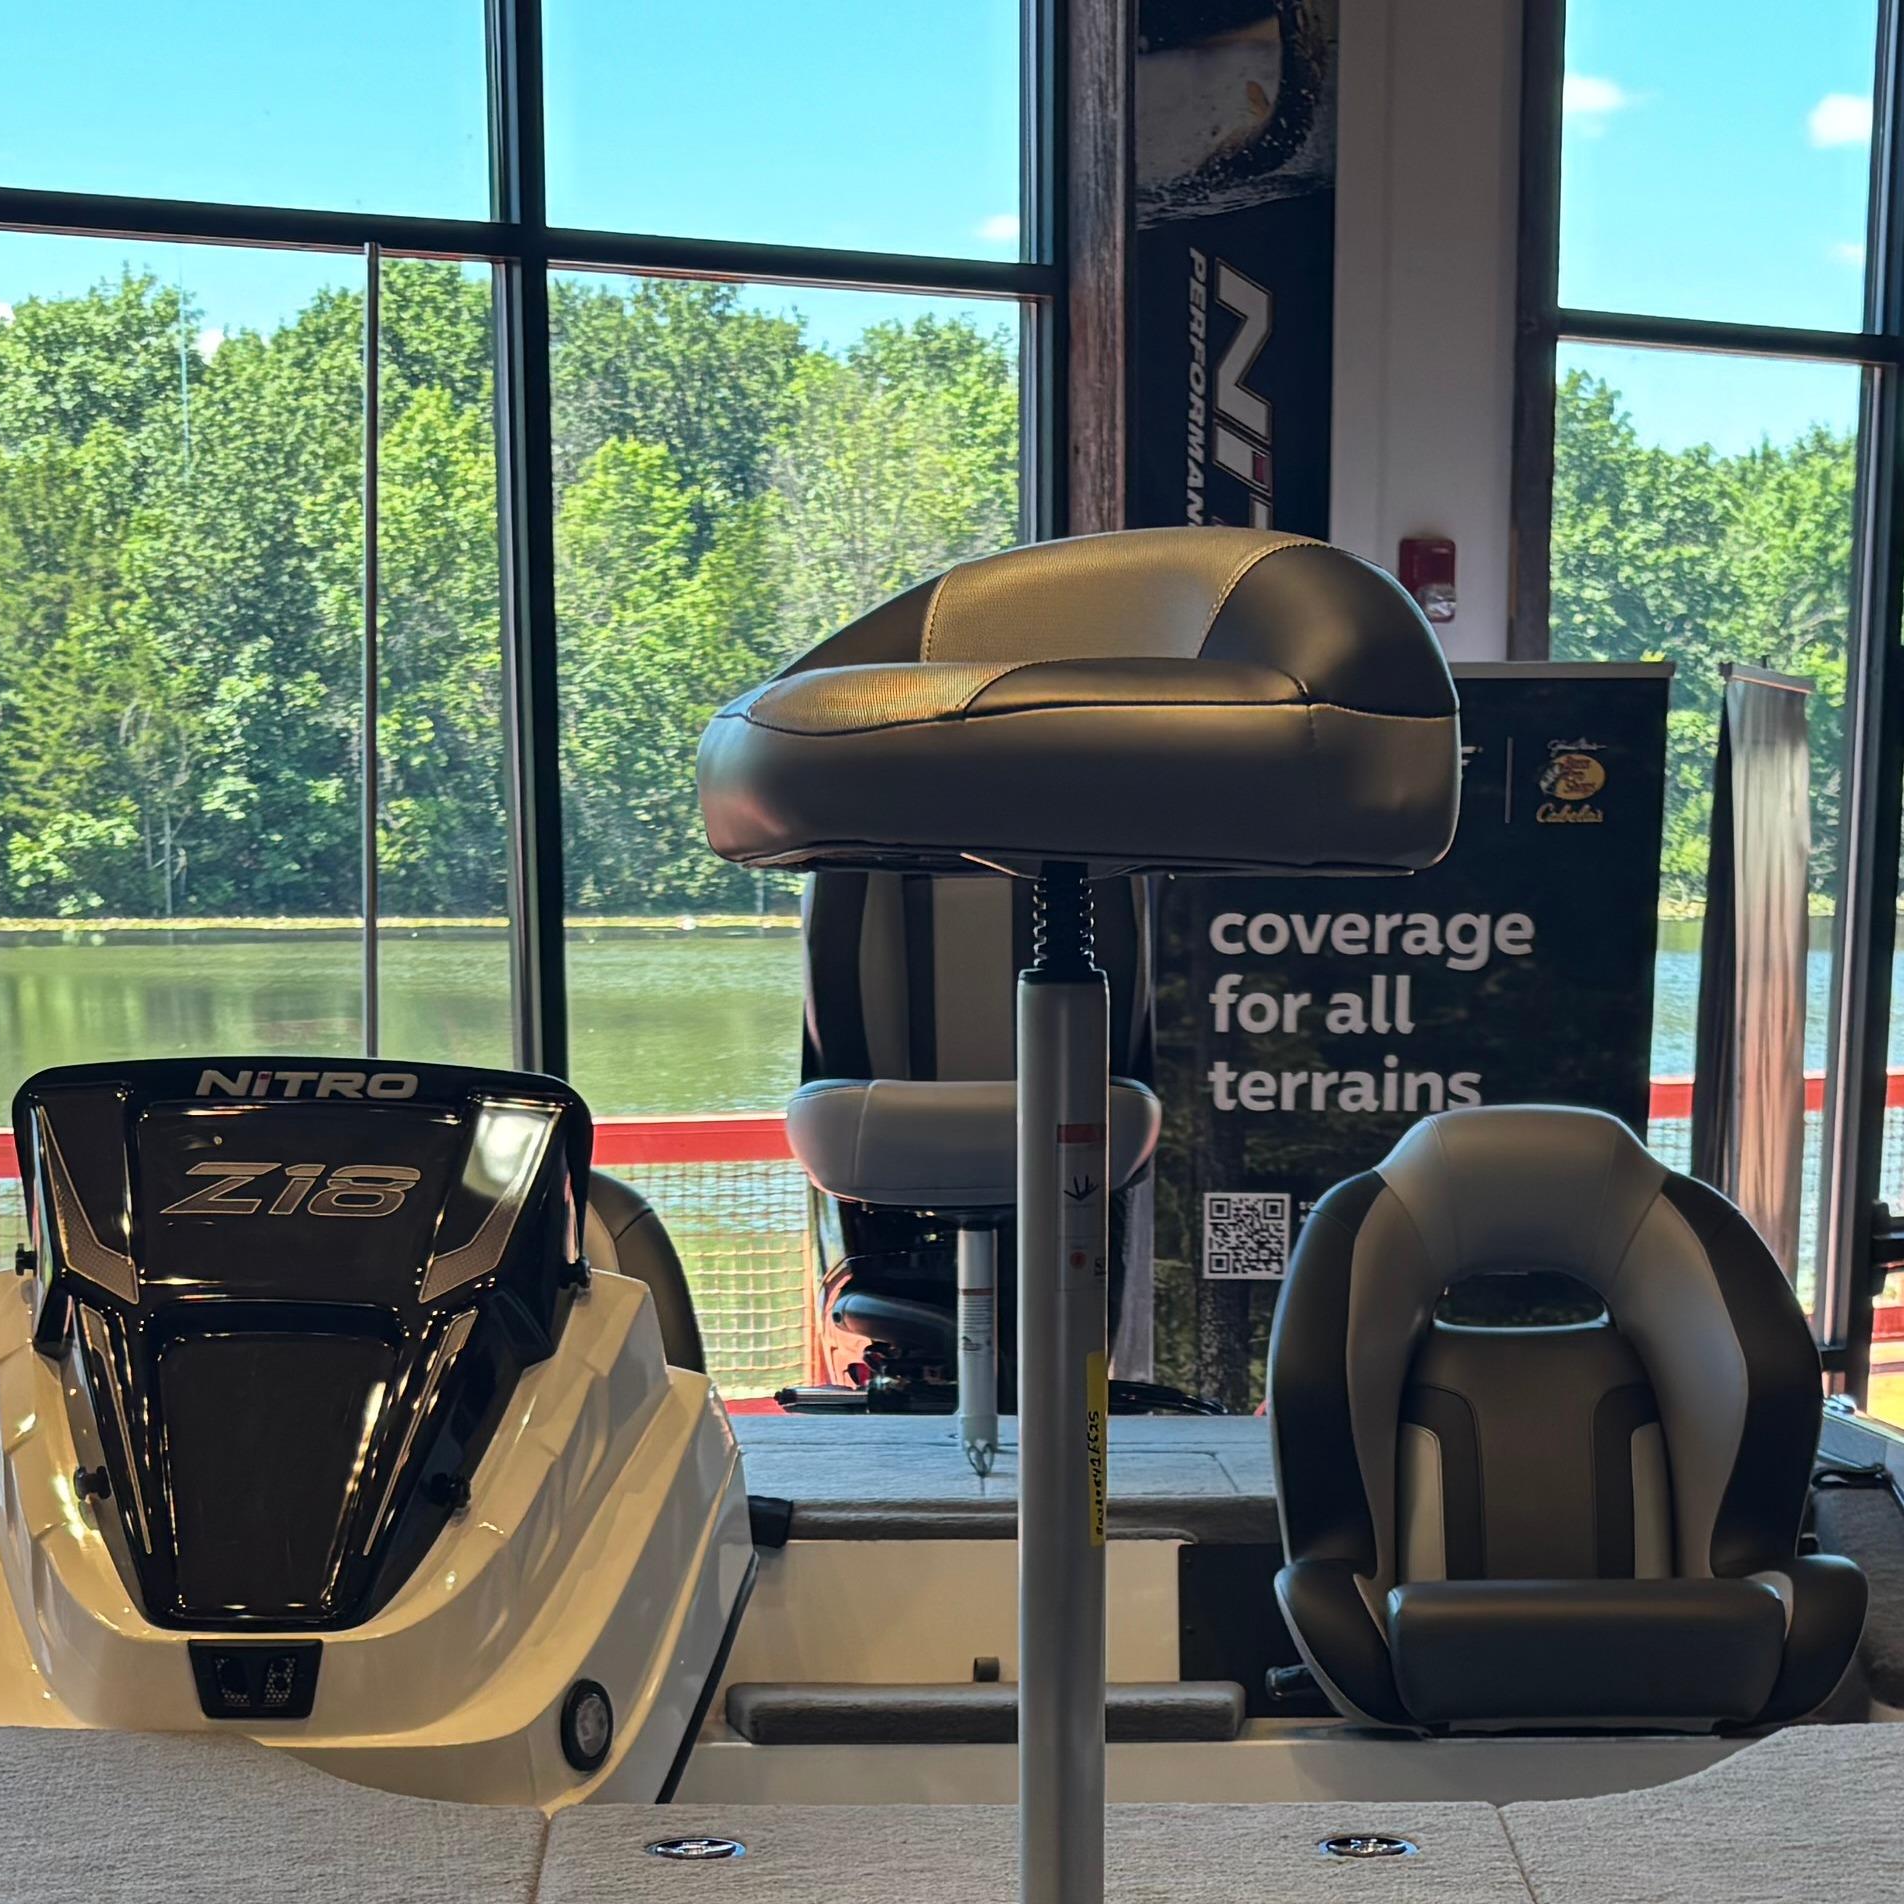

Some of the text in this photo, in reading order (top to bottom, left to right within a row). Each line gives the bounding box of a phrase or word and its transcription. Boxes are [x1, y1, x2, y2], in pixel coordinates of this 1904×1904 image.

[1209, 912, 1536, 971] coverage
[1209, 973, 1416, 1035] for all
[1208, 1055, 1483, 1112] terrains
[160, 1161, 422, 1217] Z18
